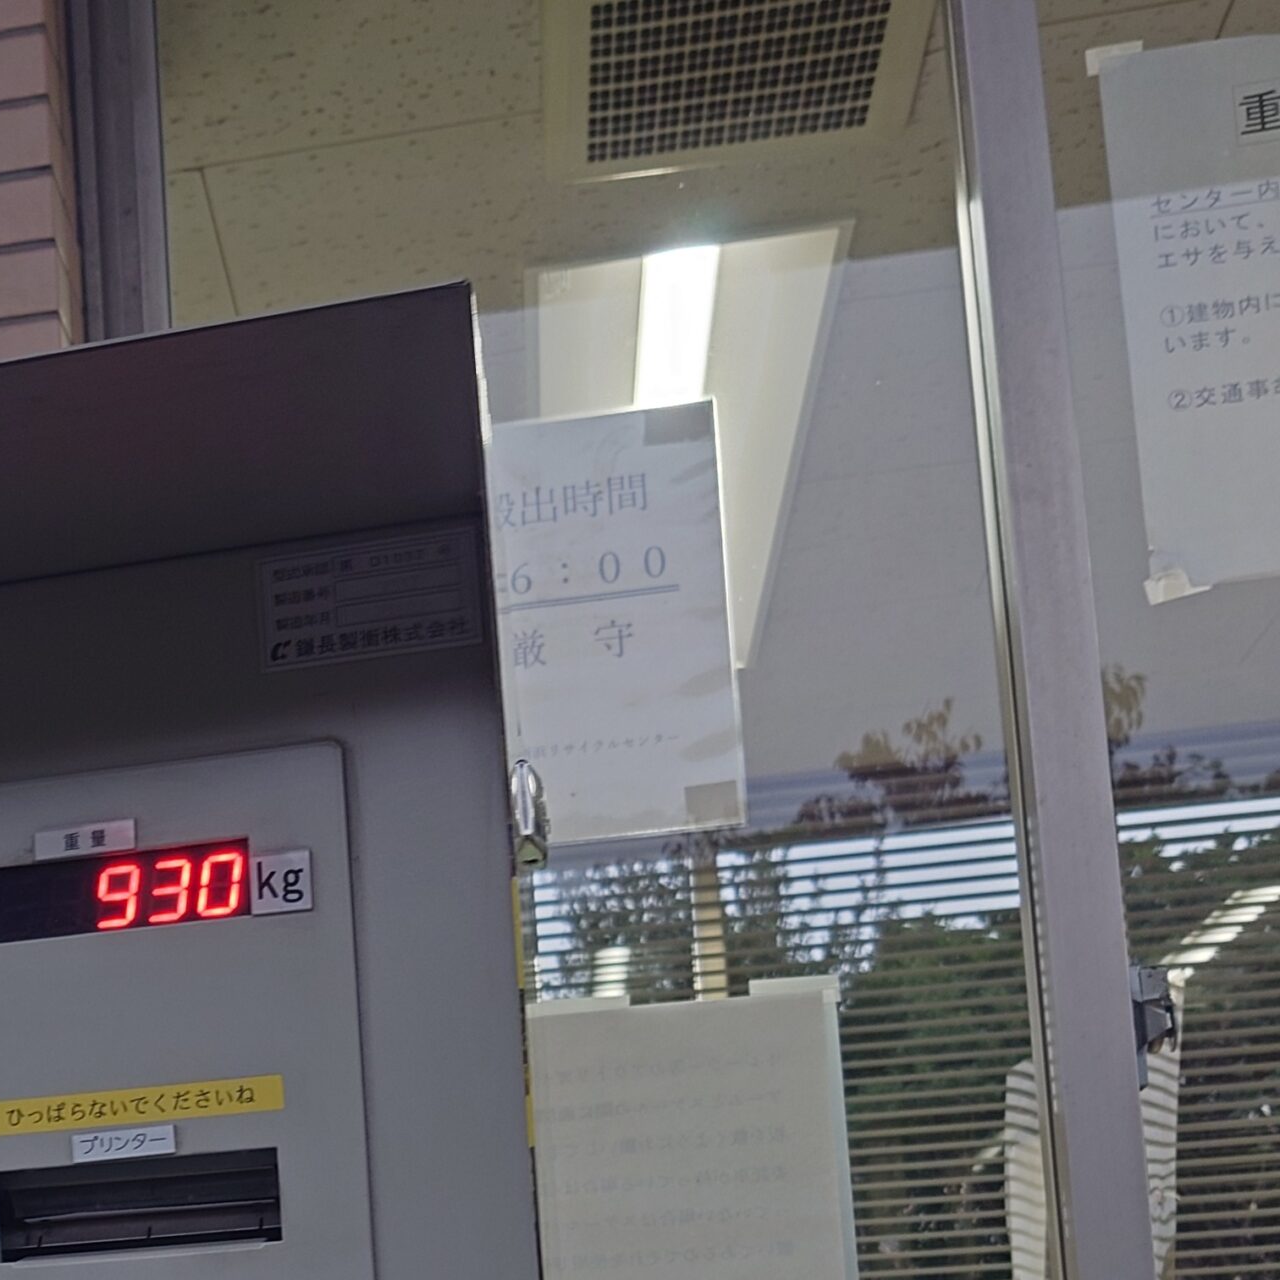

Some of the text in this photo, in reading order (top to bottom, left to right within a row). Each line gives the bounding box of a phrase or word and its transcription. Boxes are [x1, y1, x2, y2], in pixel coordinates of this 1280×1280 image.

[1152, 179, 1280, 213] センター内
[1165, 327, 1251, 354] います。
[63, 829, 107, 851] 重量
[96, 850, 246, 931] 930
[257, 861, 307, 905] kg
[6, 1085, 256, 1128] ひっぱらないでくださいね
[79, 1130, 168, 1155] プリンター
